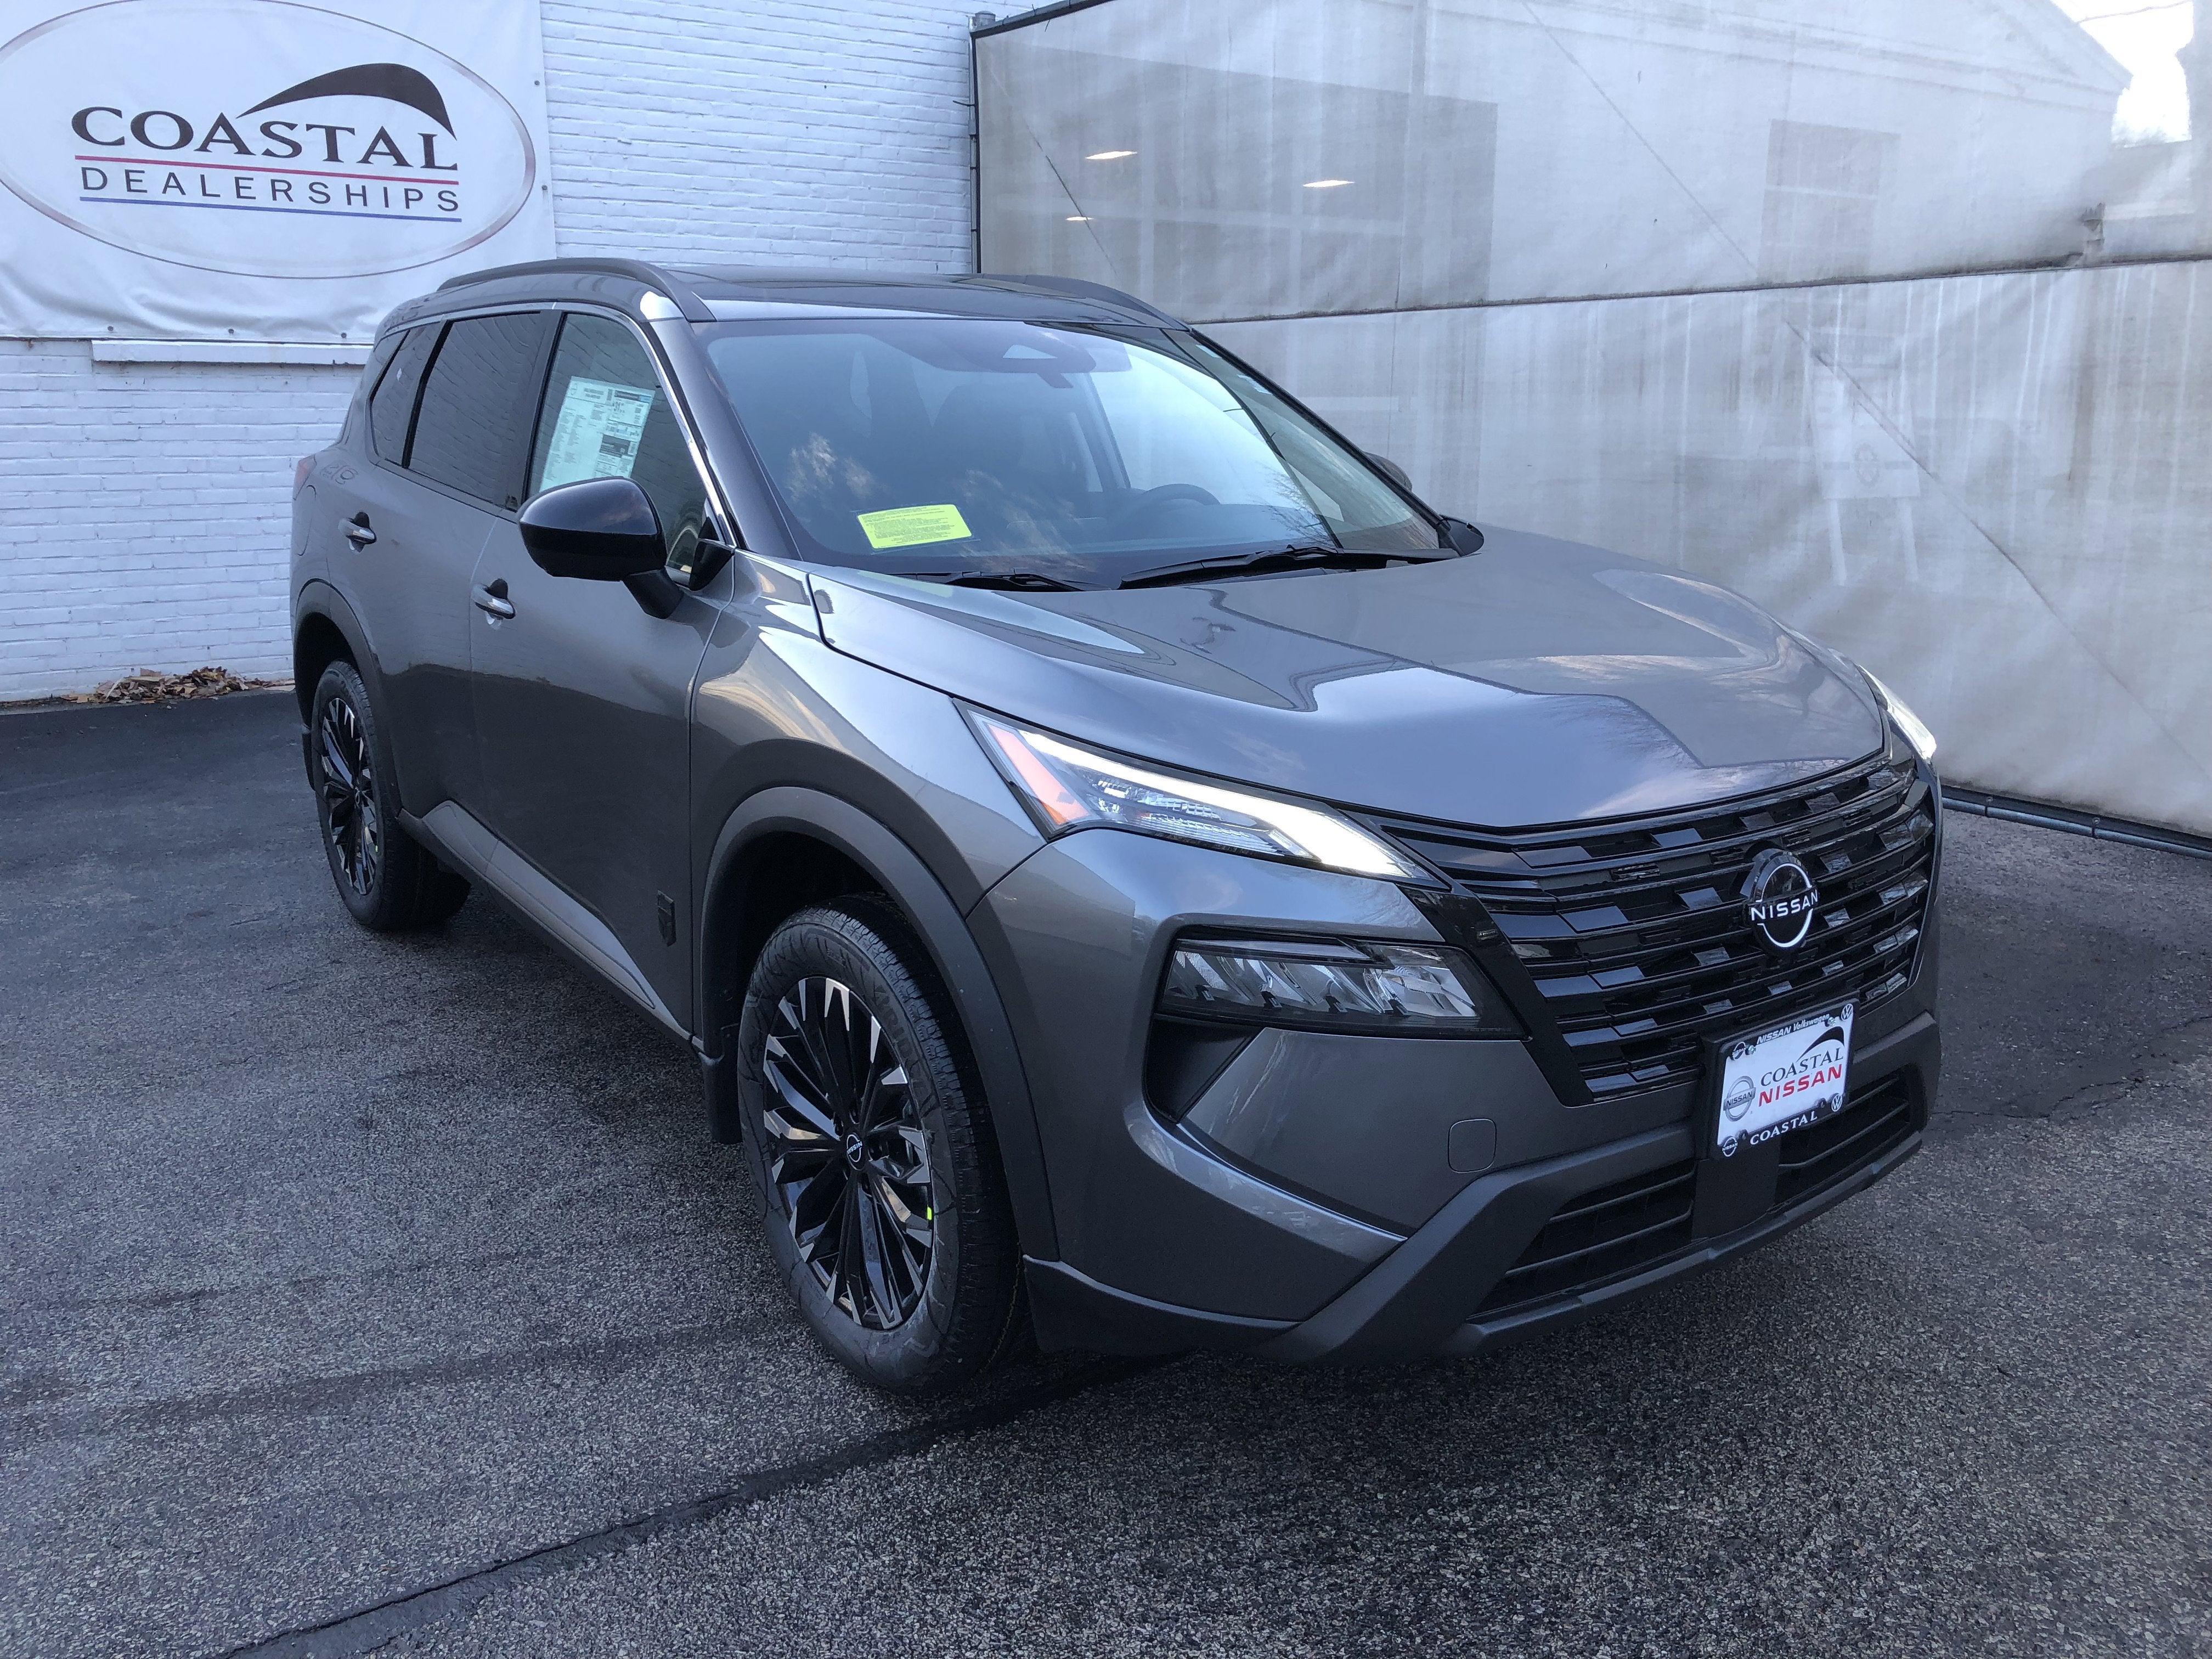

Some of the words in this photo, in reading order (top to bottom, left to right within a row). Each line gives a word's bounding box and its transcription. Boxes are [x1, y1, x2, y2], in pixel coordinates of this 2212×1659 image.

[71, 106, 458, 171] COASTAL
[81, 166, 459, 212] DEALERSHIPS
[1751, 889, 1818, 921] NISSAN
[1756, 1025, 1792, 1045] NISSAN
[1793, 1013, 1830, 1031] Volkswagen
[1758, 1063, 1843, 1107] NISSAN
[1760, 1047, 1844, 1087] COASTAL
[1725, 1091, 1753, 1107] NISSAN
[1750, 1110, 1818, 1146] COASTAL
